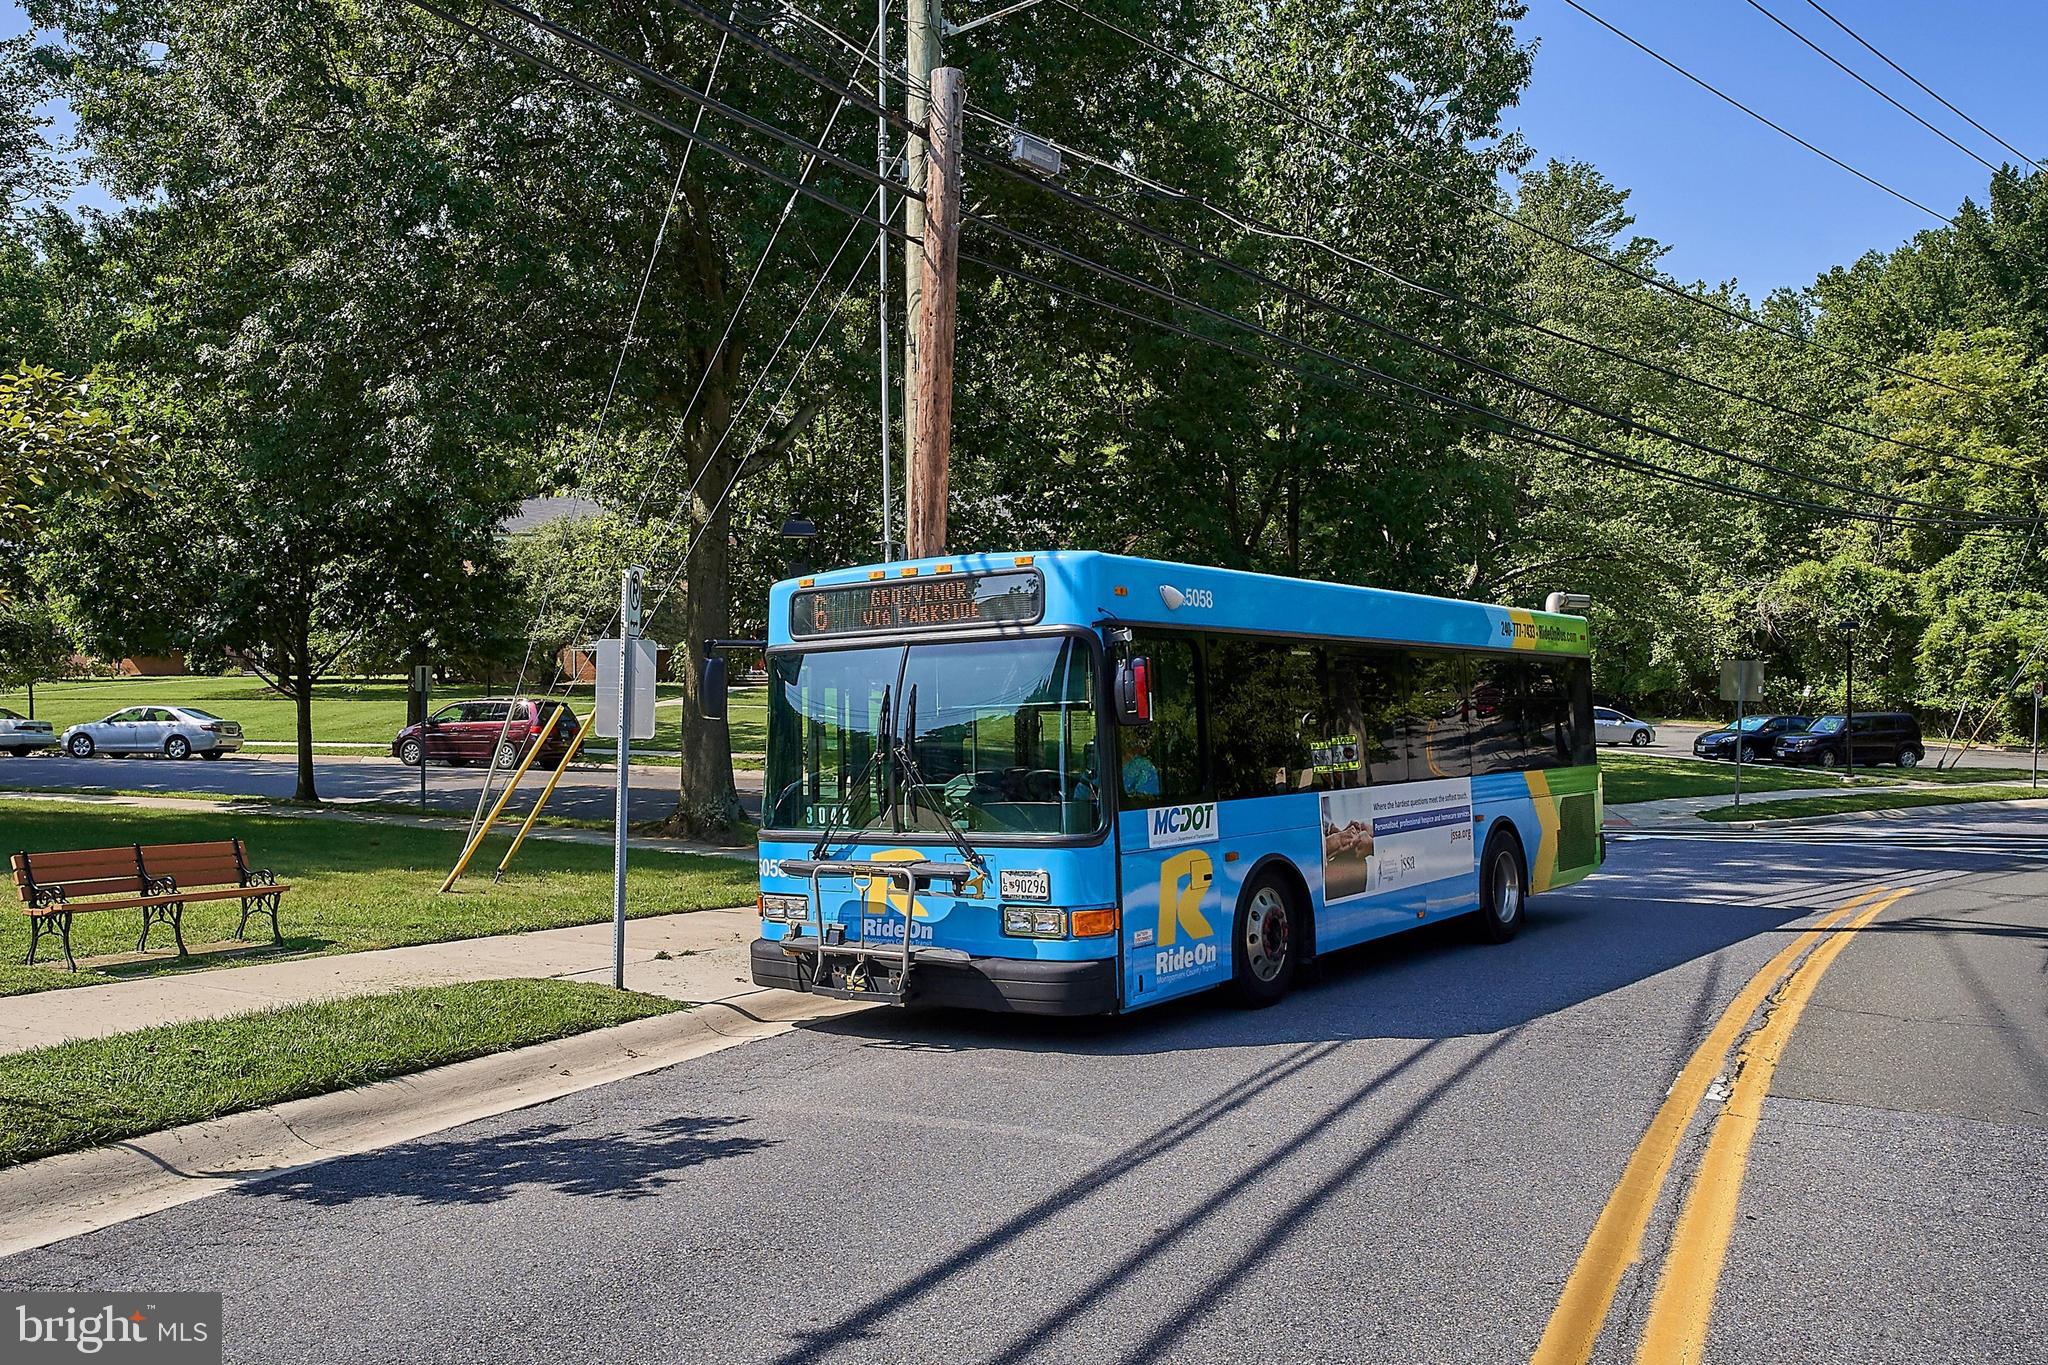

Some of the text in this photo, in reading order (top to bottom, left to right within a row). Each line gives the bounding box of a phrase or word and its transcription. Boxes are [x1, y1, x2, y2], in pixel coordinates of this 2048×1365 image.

[871, 581, 968, 607] GROSVENOR
[1185, 588, 1213, 609] 5058
[814, 593, 828, 631] 6
[863, 602, 980, 627] VIA PARKSIDE
[1373, 802, 1387, 811] Where
[1387, 801, 1395, 809] the
[1395, 799, 1410, 809] hardest
[1410, 797, 1429, 808] questions
[1429, 796, 1439, 804] meet
[806, 806, 850, 825] 3042
[1154, 804, 1214, 836] MCDOT
[1399, 816, 1421, 830] professional
[1450, 828, 1472, 844] jssa.org
[1400, 854, 1416, 879] jssa
[1014, 878, 1047, 894] 90296
